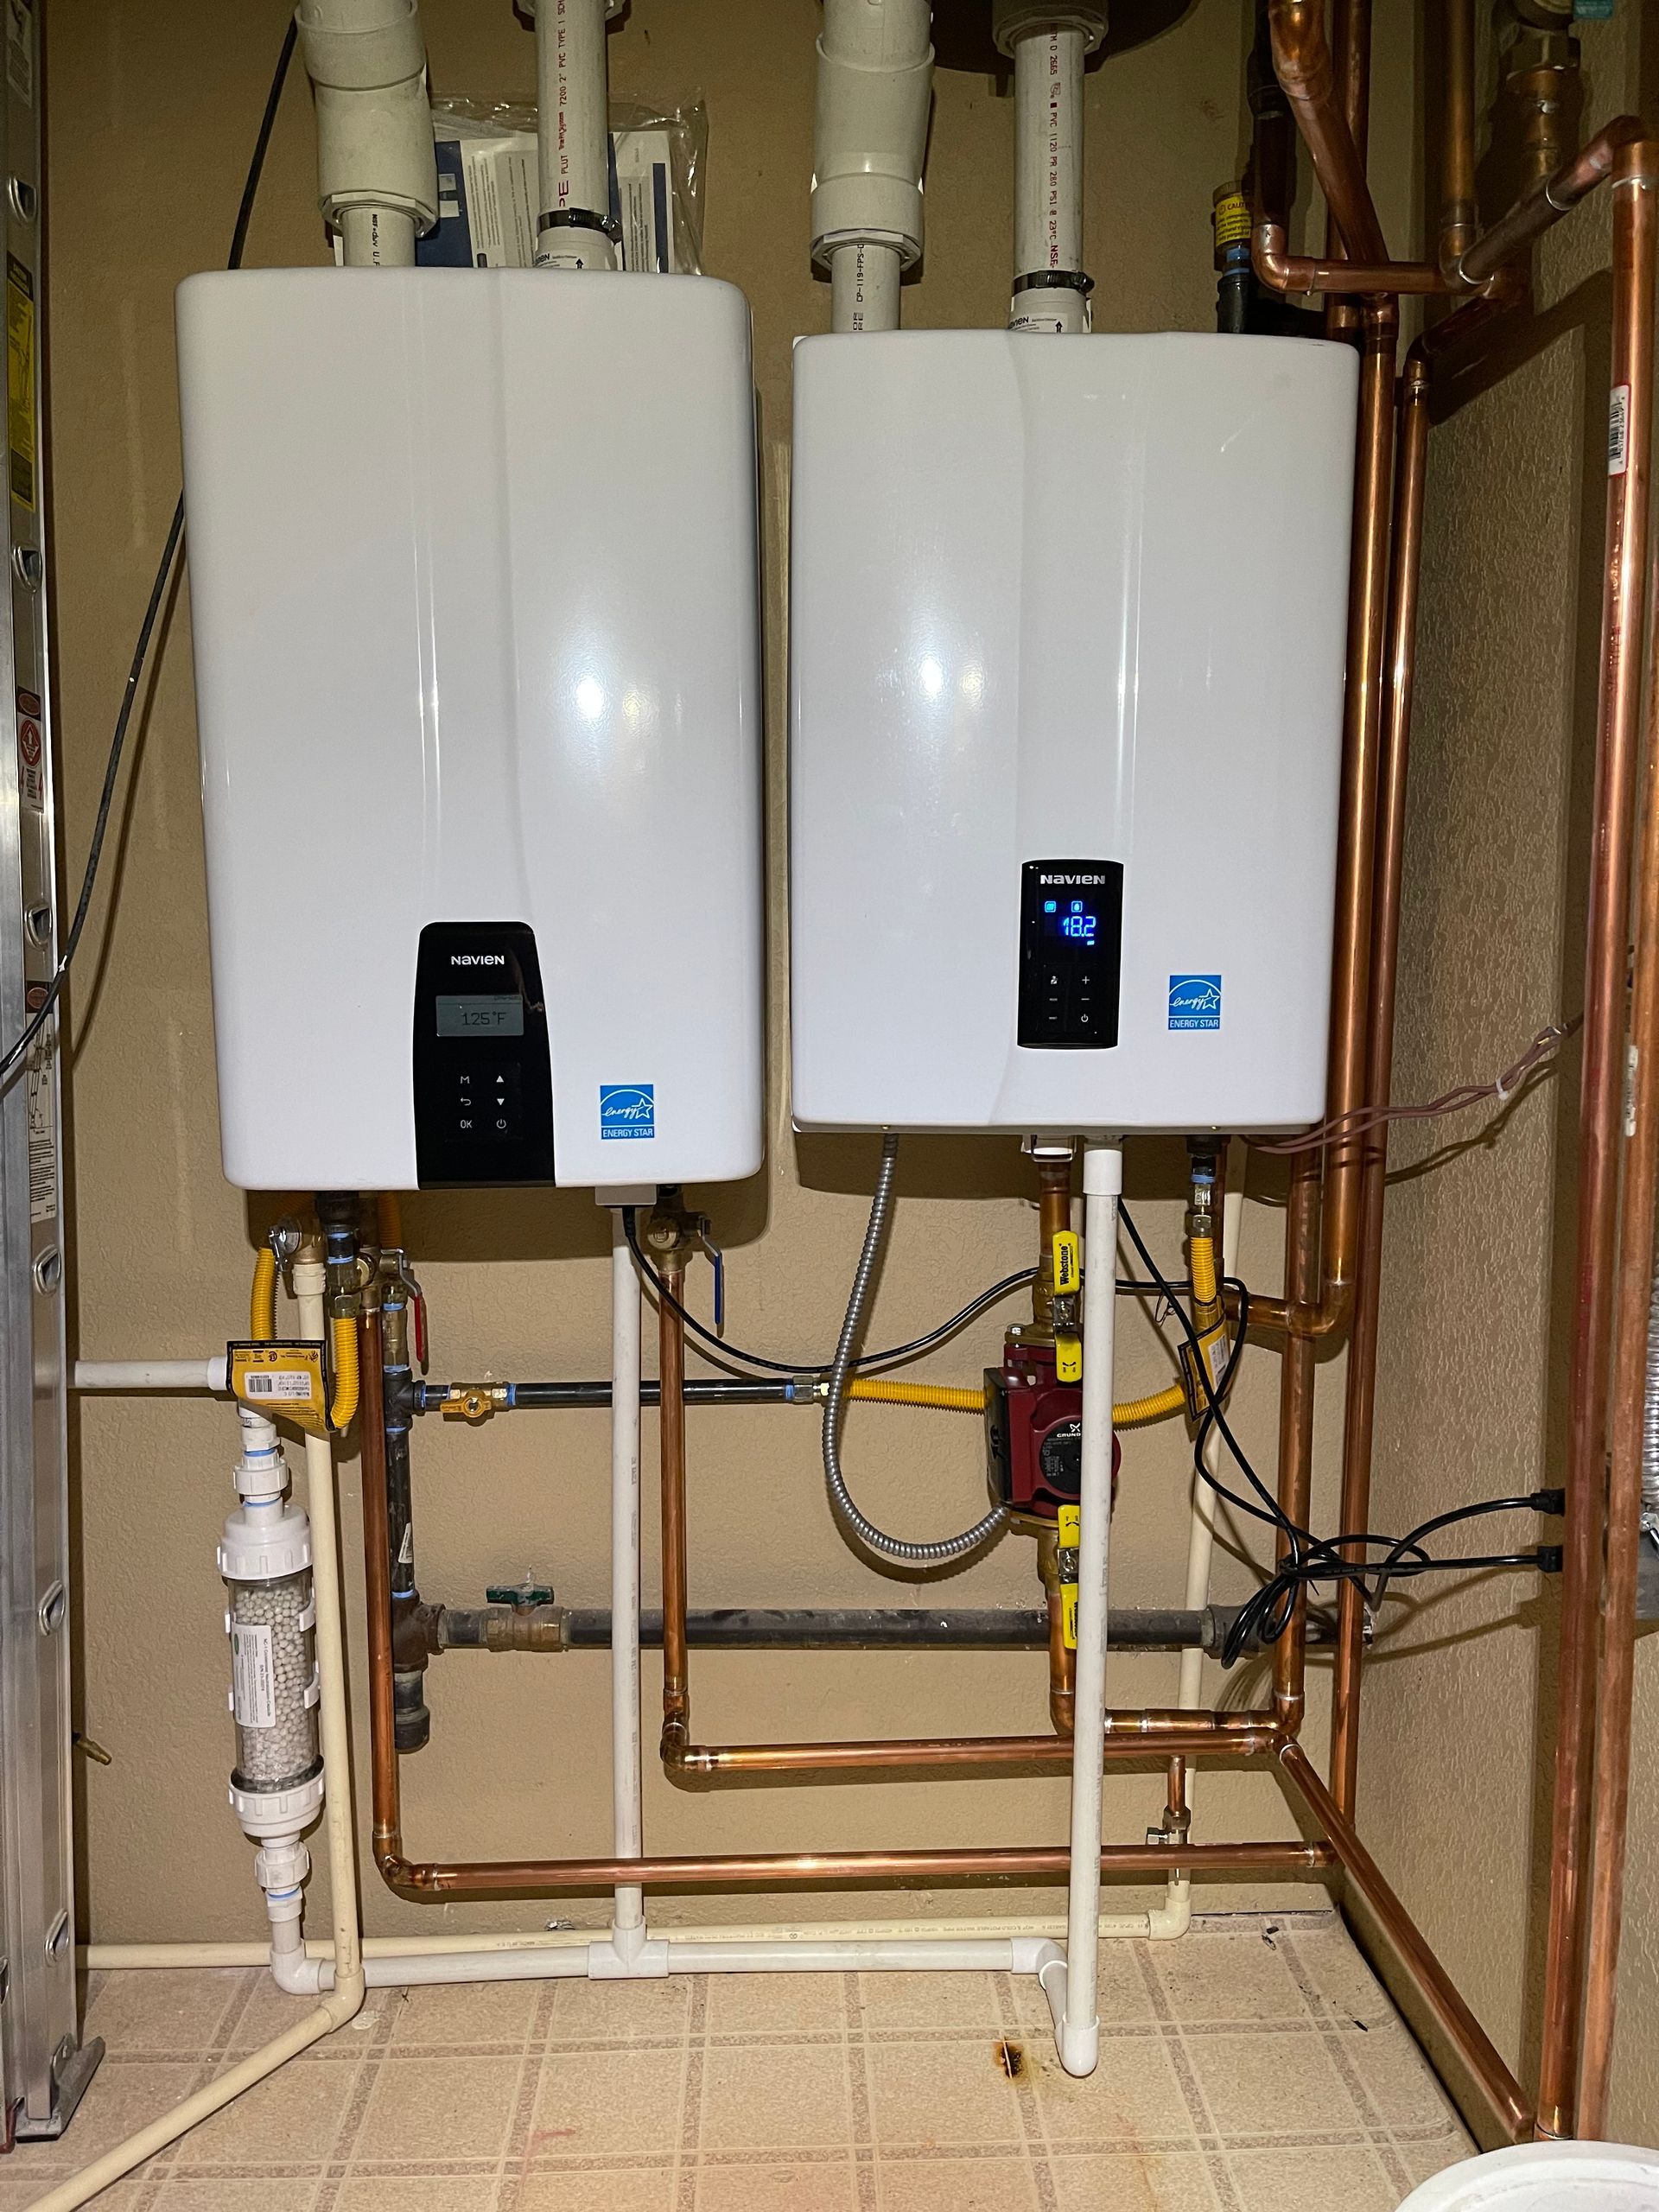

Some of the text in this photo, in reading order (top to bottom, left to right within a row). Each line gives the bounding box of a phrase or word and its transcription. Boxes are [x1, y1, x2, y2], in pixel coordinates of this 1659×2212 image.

[557, 28, 566, 48] TYPE
[1050, 156, 1058, 167] PR
[1063, 915, 1096, 938] 18.2
[461, 1011, 507, 1026] 125°F
[1169, 1019, 1219, 1028] ENERGY STAR
[460, 1120, 473, 1128] OK
[602, 1128, 653, 1138] ENERGY STAR
[1059, 1245, 1070, 1286] Webstone
